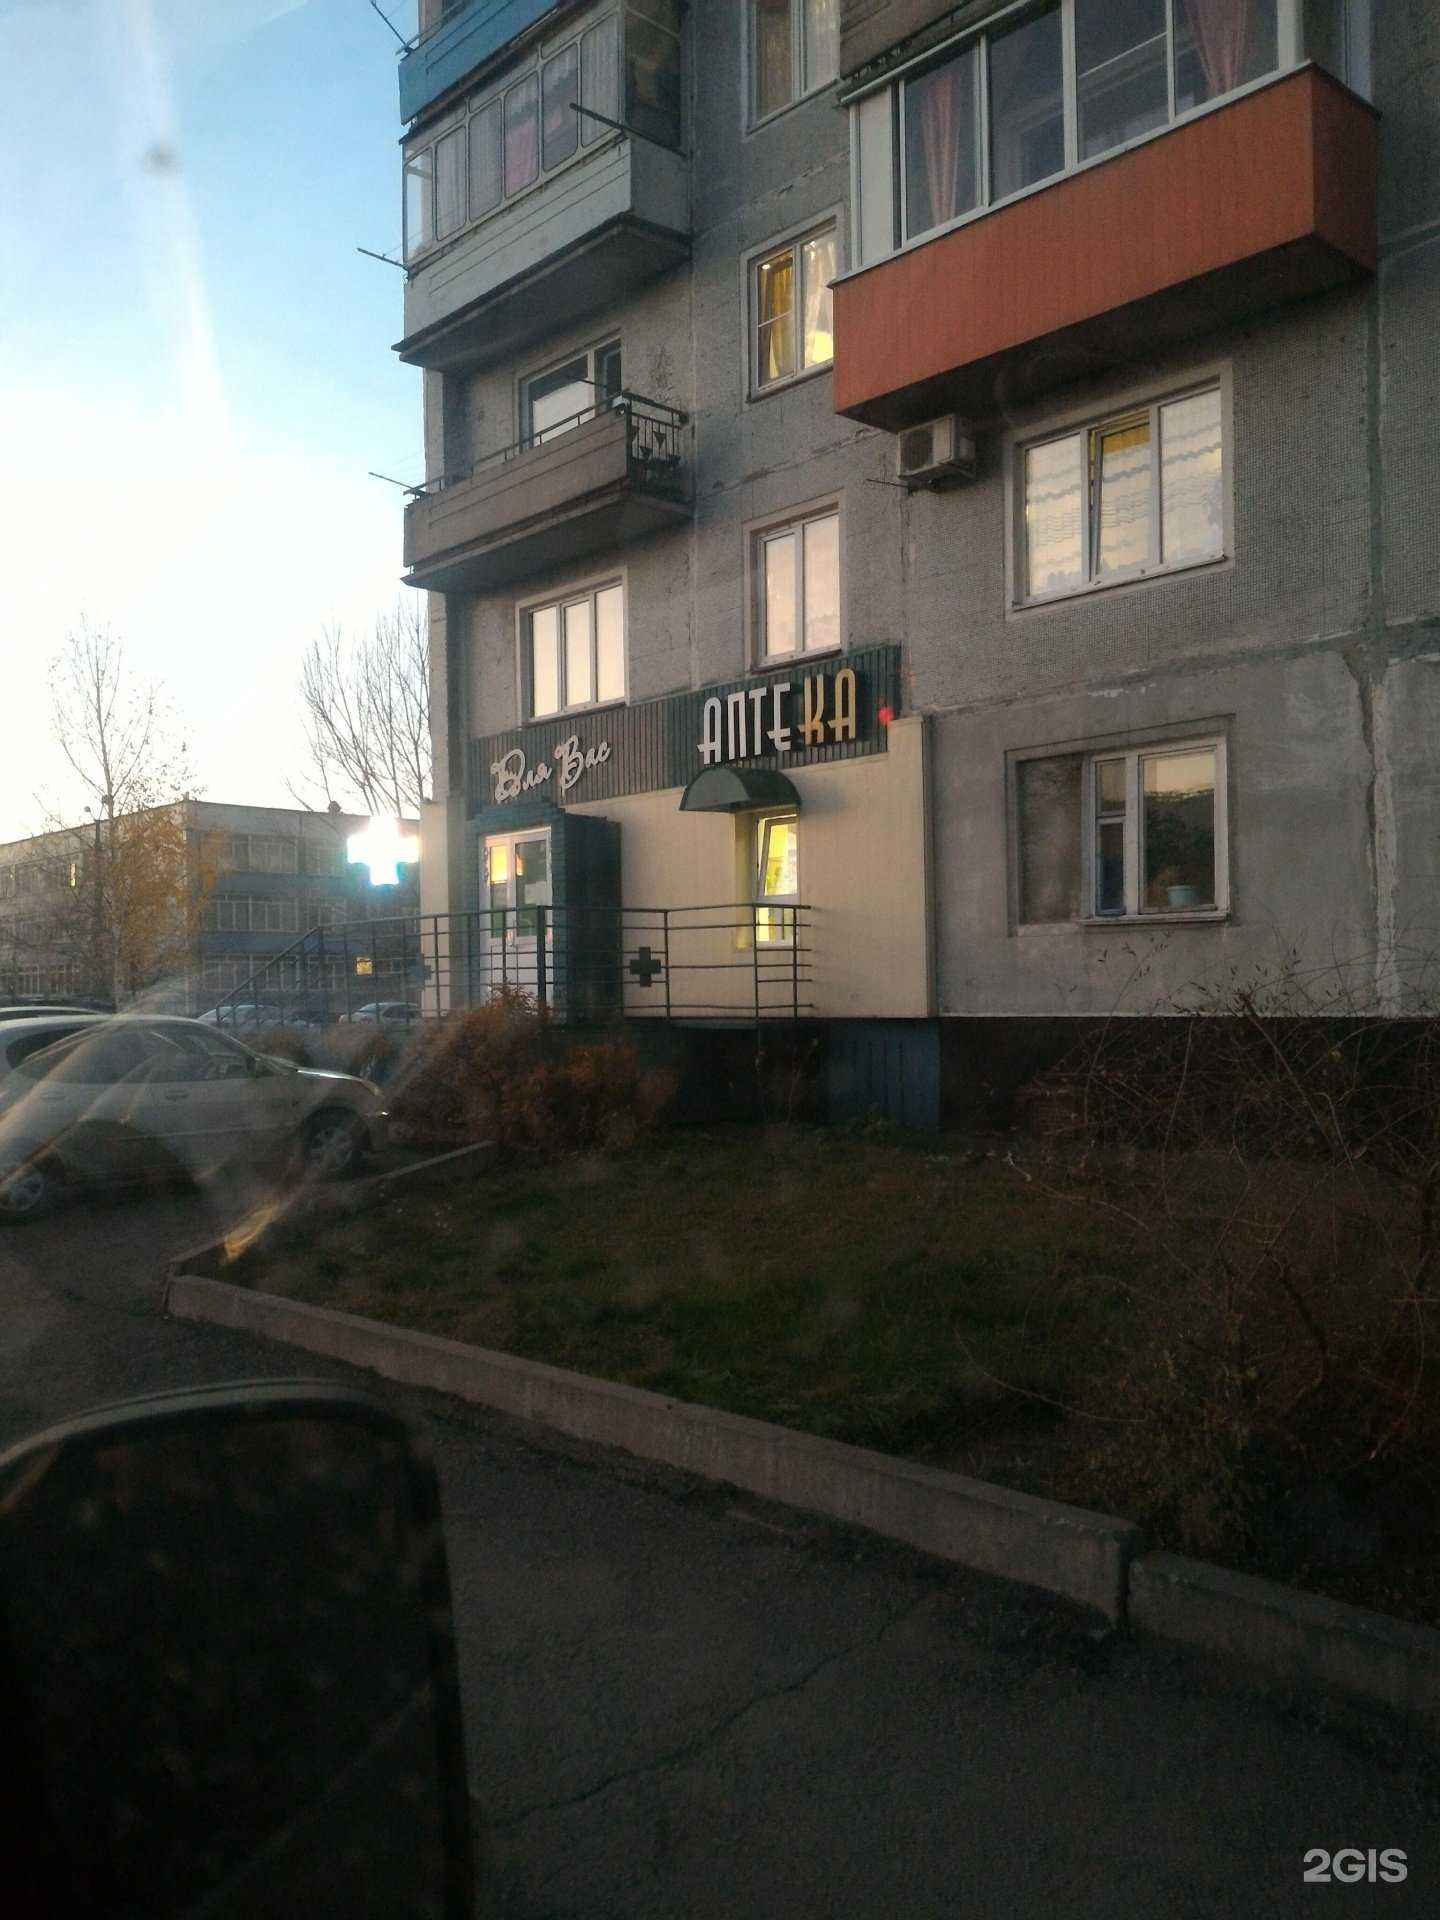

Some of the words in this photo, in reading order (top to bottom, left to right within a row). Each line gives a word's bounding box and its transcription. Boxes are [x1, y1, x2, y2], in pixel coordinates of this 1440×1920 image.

[697, 668, 855, 764] АПТЕКА
[490, 748, 552, 801] Для
[554, 735, 611, 799] Вас
